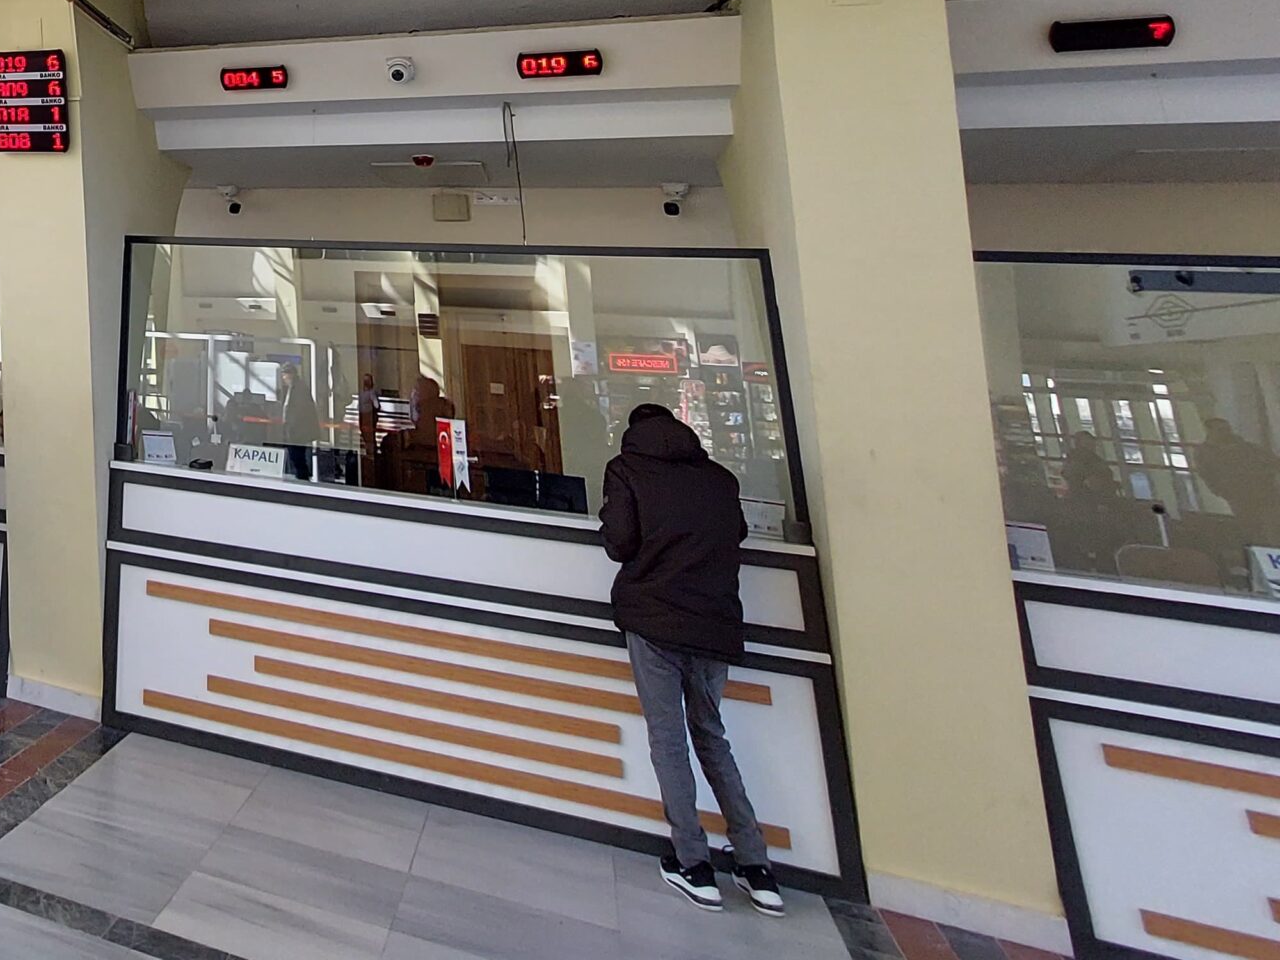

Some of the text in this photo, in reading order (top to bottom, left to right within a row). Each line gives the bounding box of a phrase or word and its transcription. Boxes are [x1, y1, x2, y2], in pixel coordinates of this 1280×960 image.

[47, 55, 60, 71] 6
[521, 57, 566, 75] 019
[271, 70, 283, 83] 5
[52, 132, 64, 149] 1
[233, 448, 279, 464] KAPALI
